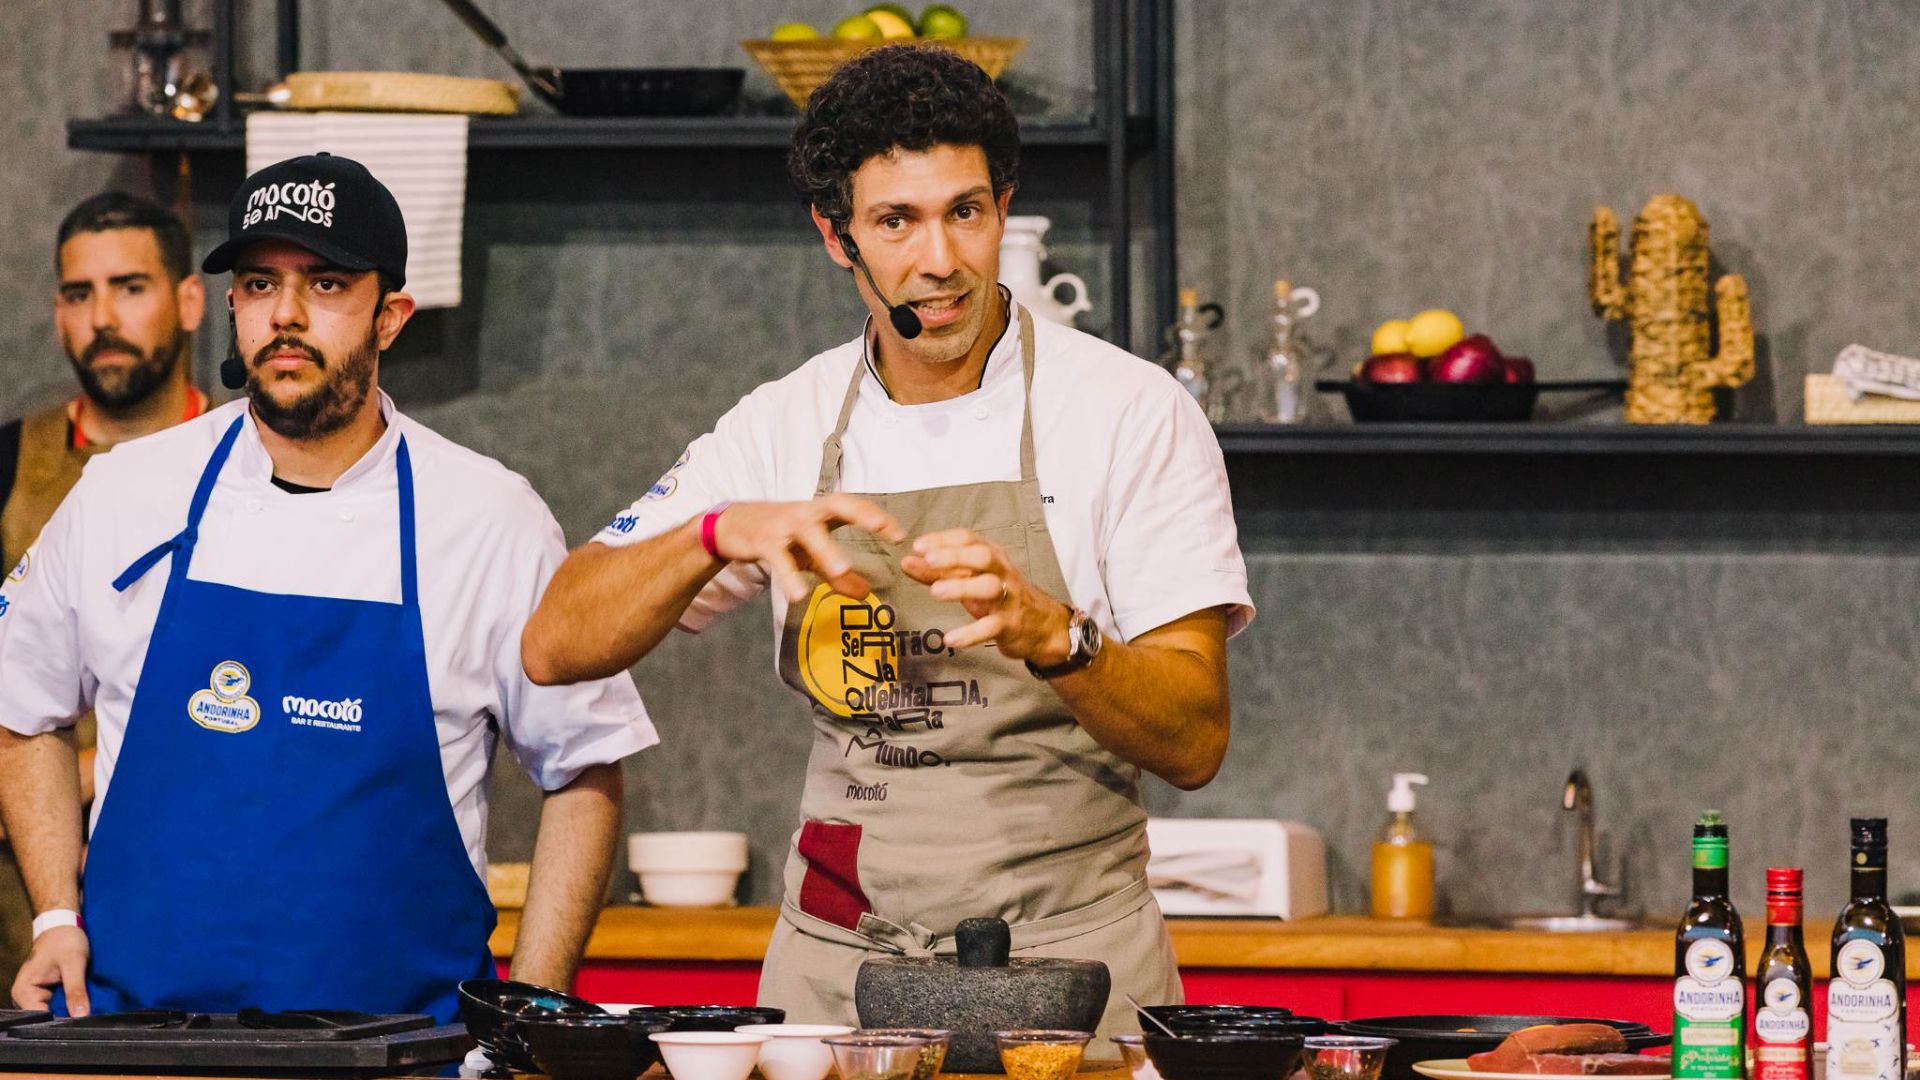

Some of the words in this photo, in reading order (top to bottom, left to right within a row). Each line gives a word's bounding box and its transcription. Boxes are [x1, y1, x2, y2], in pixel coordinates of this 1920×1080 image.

[247, 180, 335, 211] mocotó
[242, 208, 262, 230] 50
[264, 204, 334, 228] ANOS
[840, 604, 896, 631] DO
[842, 659, 898, 685] Na
[196, 701, 250, 721] ANDORINHA
[282, 695, 363, 723] mocotó
[291, 717, 306, 725] BAR
[1678, 991, 1741, 1005] ANDORINHA
[1829, 992, 1892, 1008] ANDORINHA
